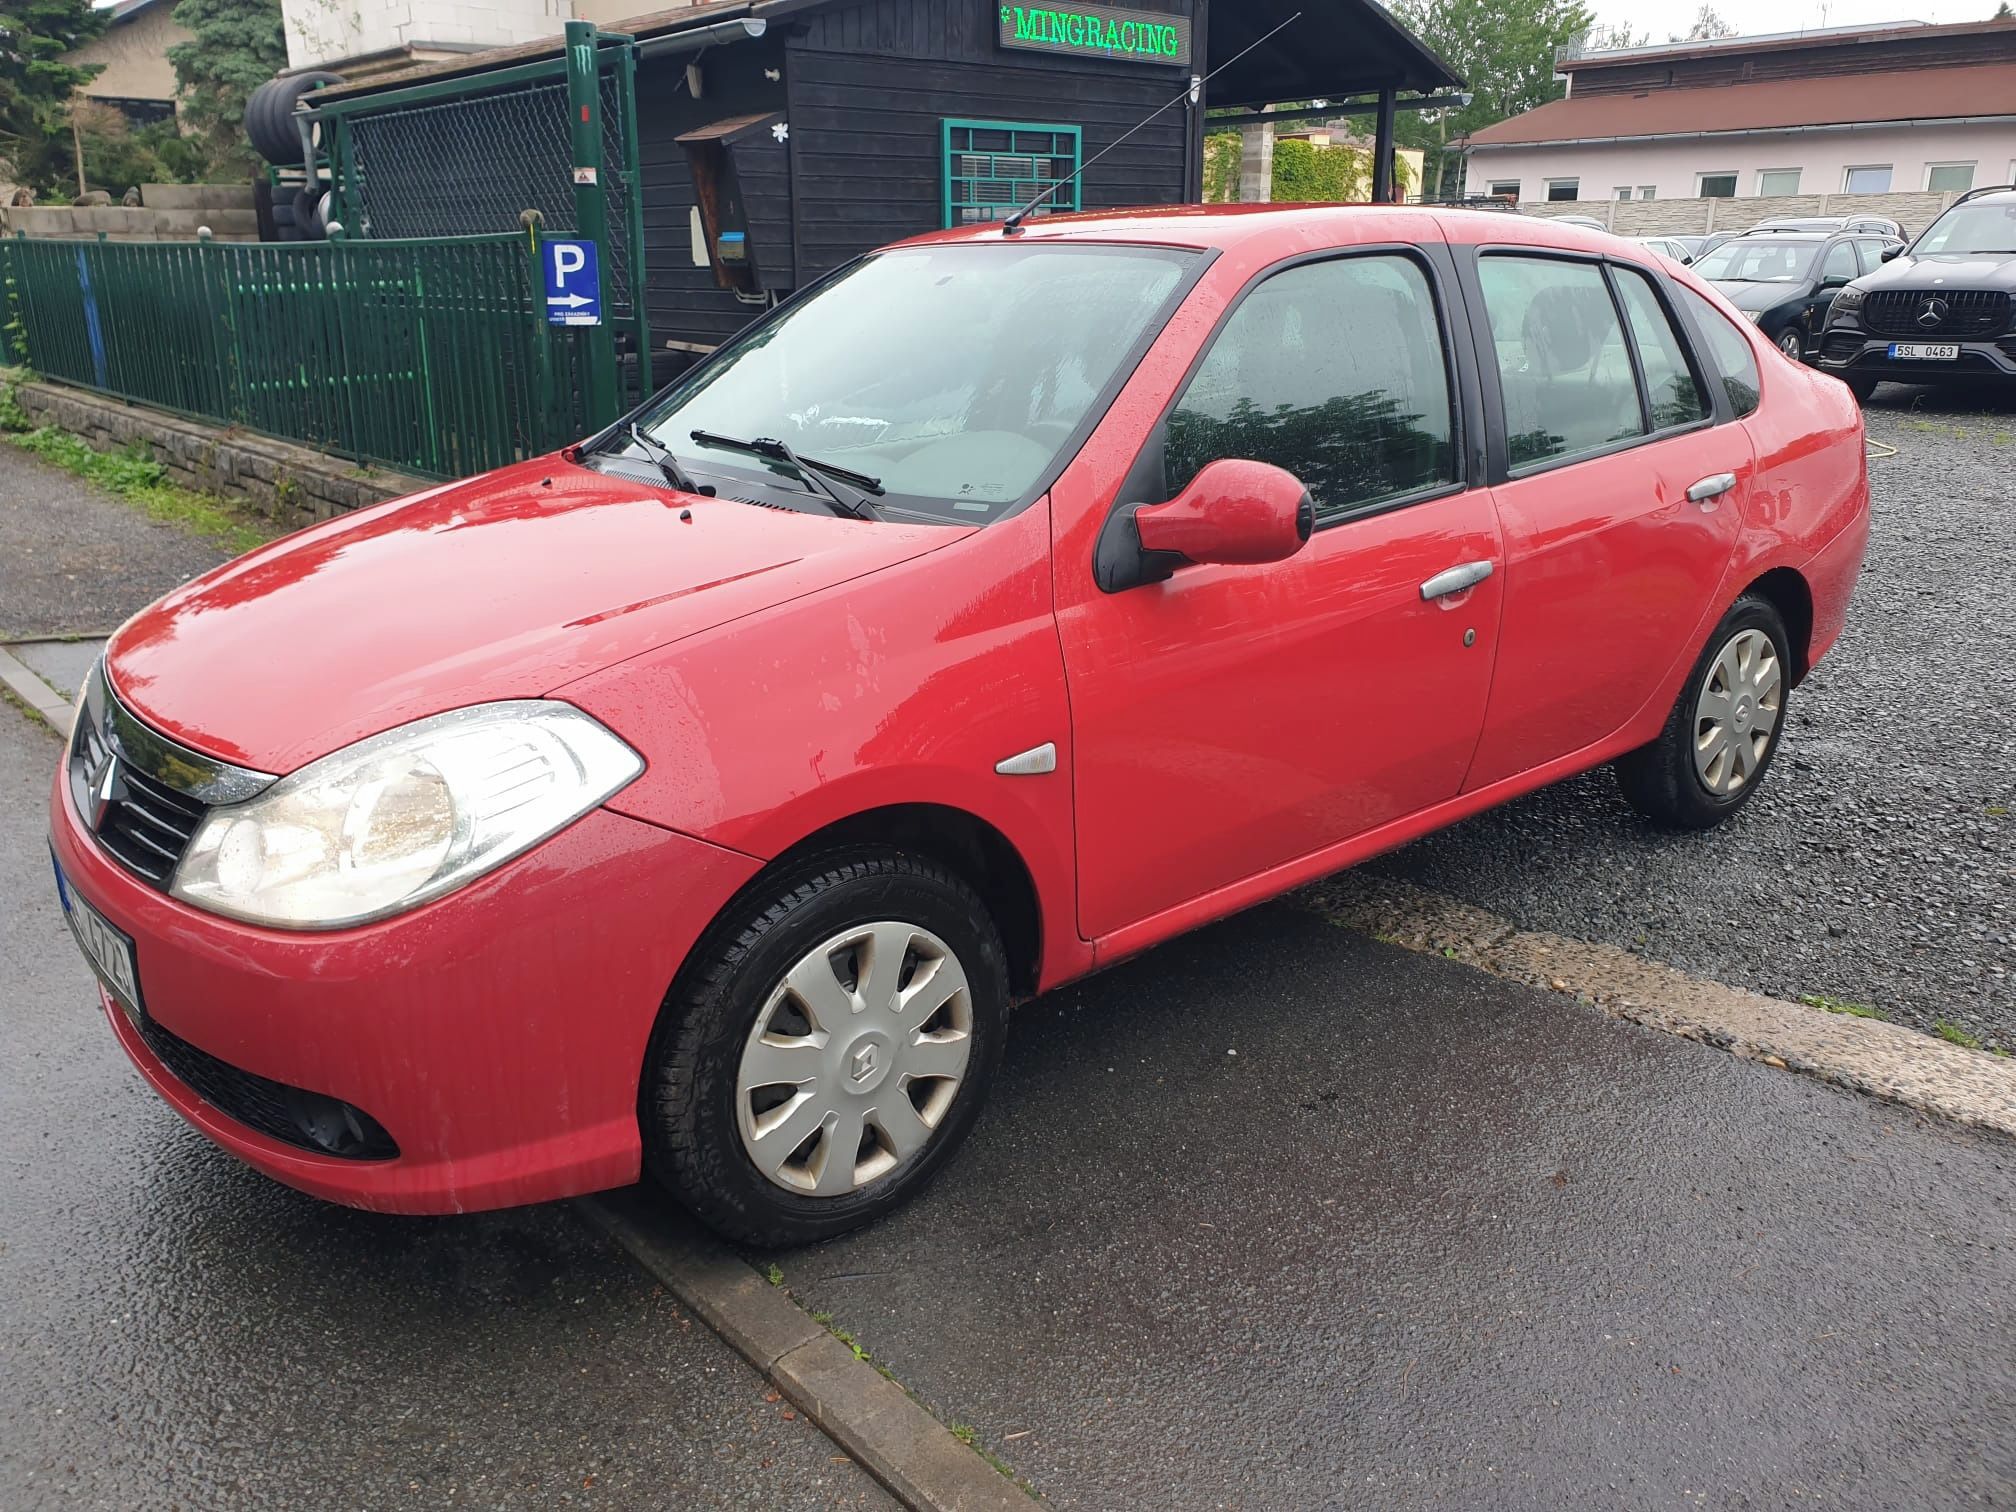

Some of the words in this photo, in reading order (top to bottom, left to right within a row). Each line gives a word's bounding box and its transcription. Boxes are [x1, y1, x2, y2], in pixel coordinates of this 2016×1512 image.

[1013, 7, 1178, 57] MINGRACING
[554, 244, 585, 288] P
[1897, 346, 1917, 356] 5SL
[1925, 346, 1954, 357] 0463
